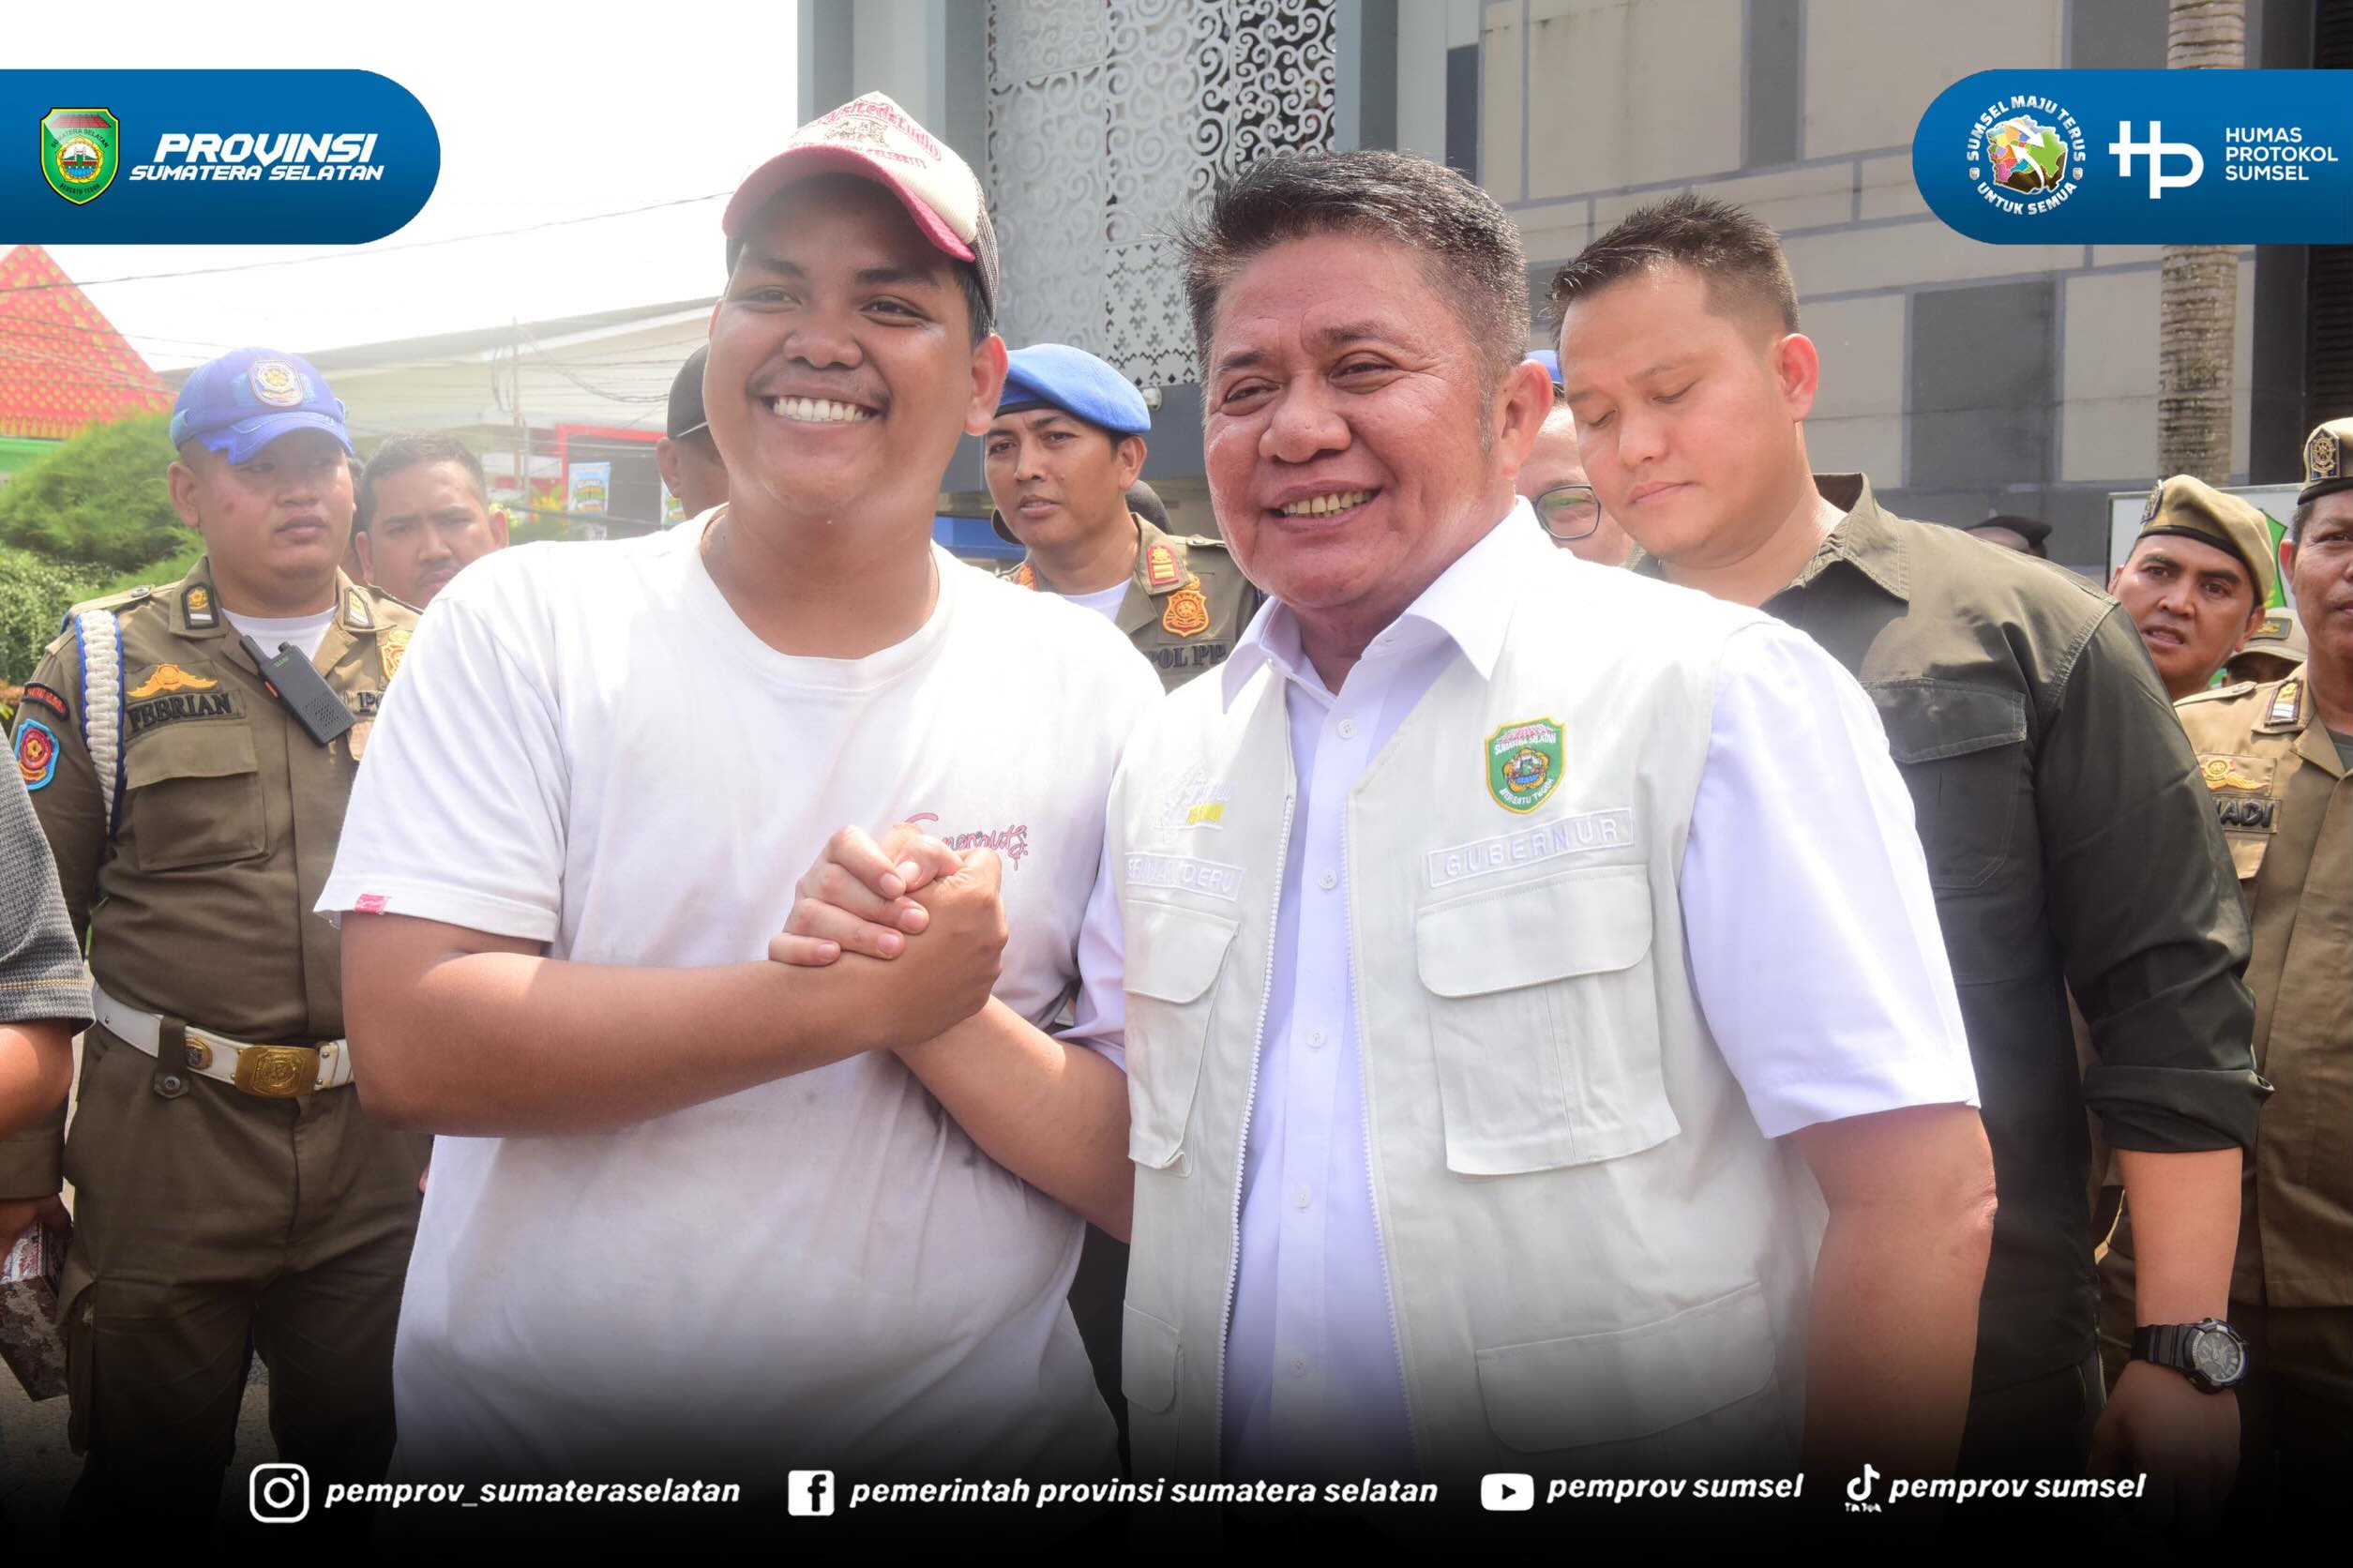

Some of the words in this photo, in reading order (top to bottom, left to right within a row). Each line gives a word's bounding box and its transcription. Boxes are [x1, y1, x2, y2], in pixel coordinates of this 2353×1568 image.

[128, 693, 233, 731] FEBRIAN
[2216, 799, 2274, 828] ADI
[1445, 817, 1619, 878] GUBERNUR
